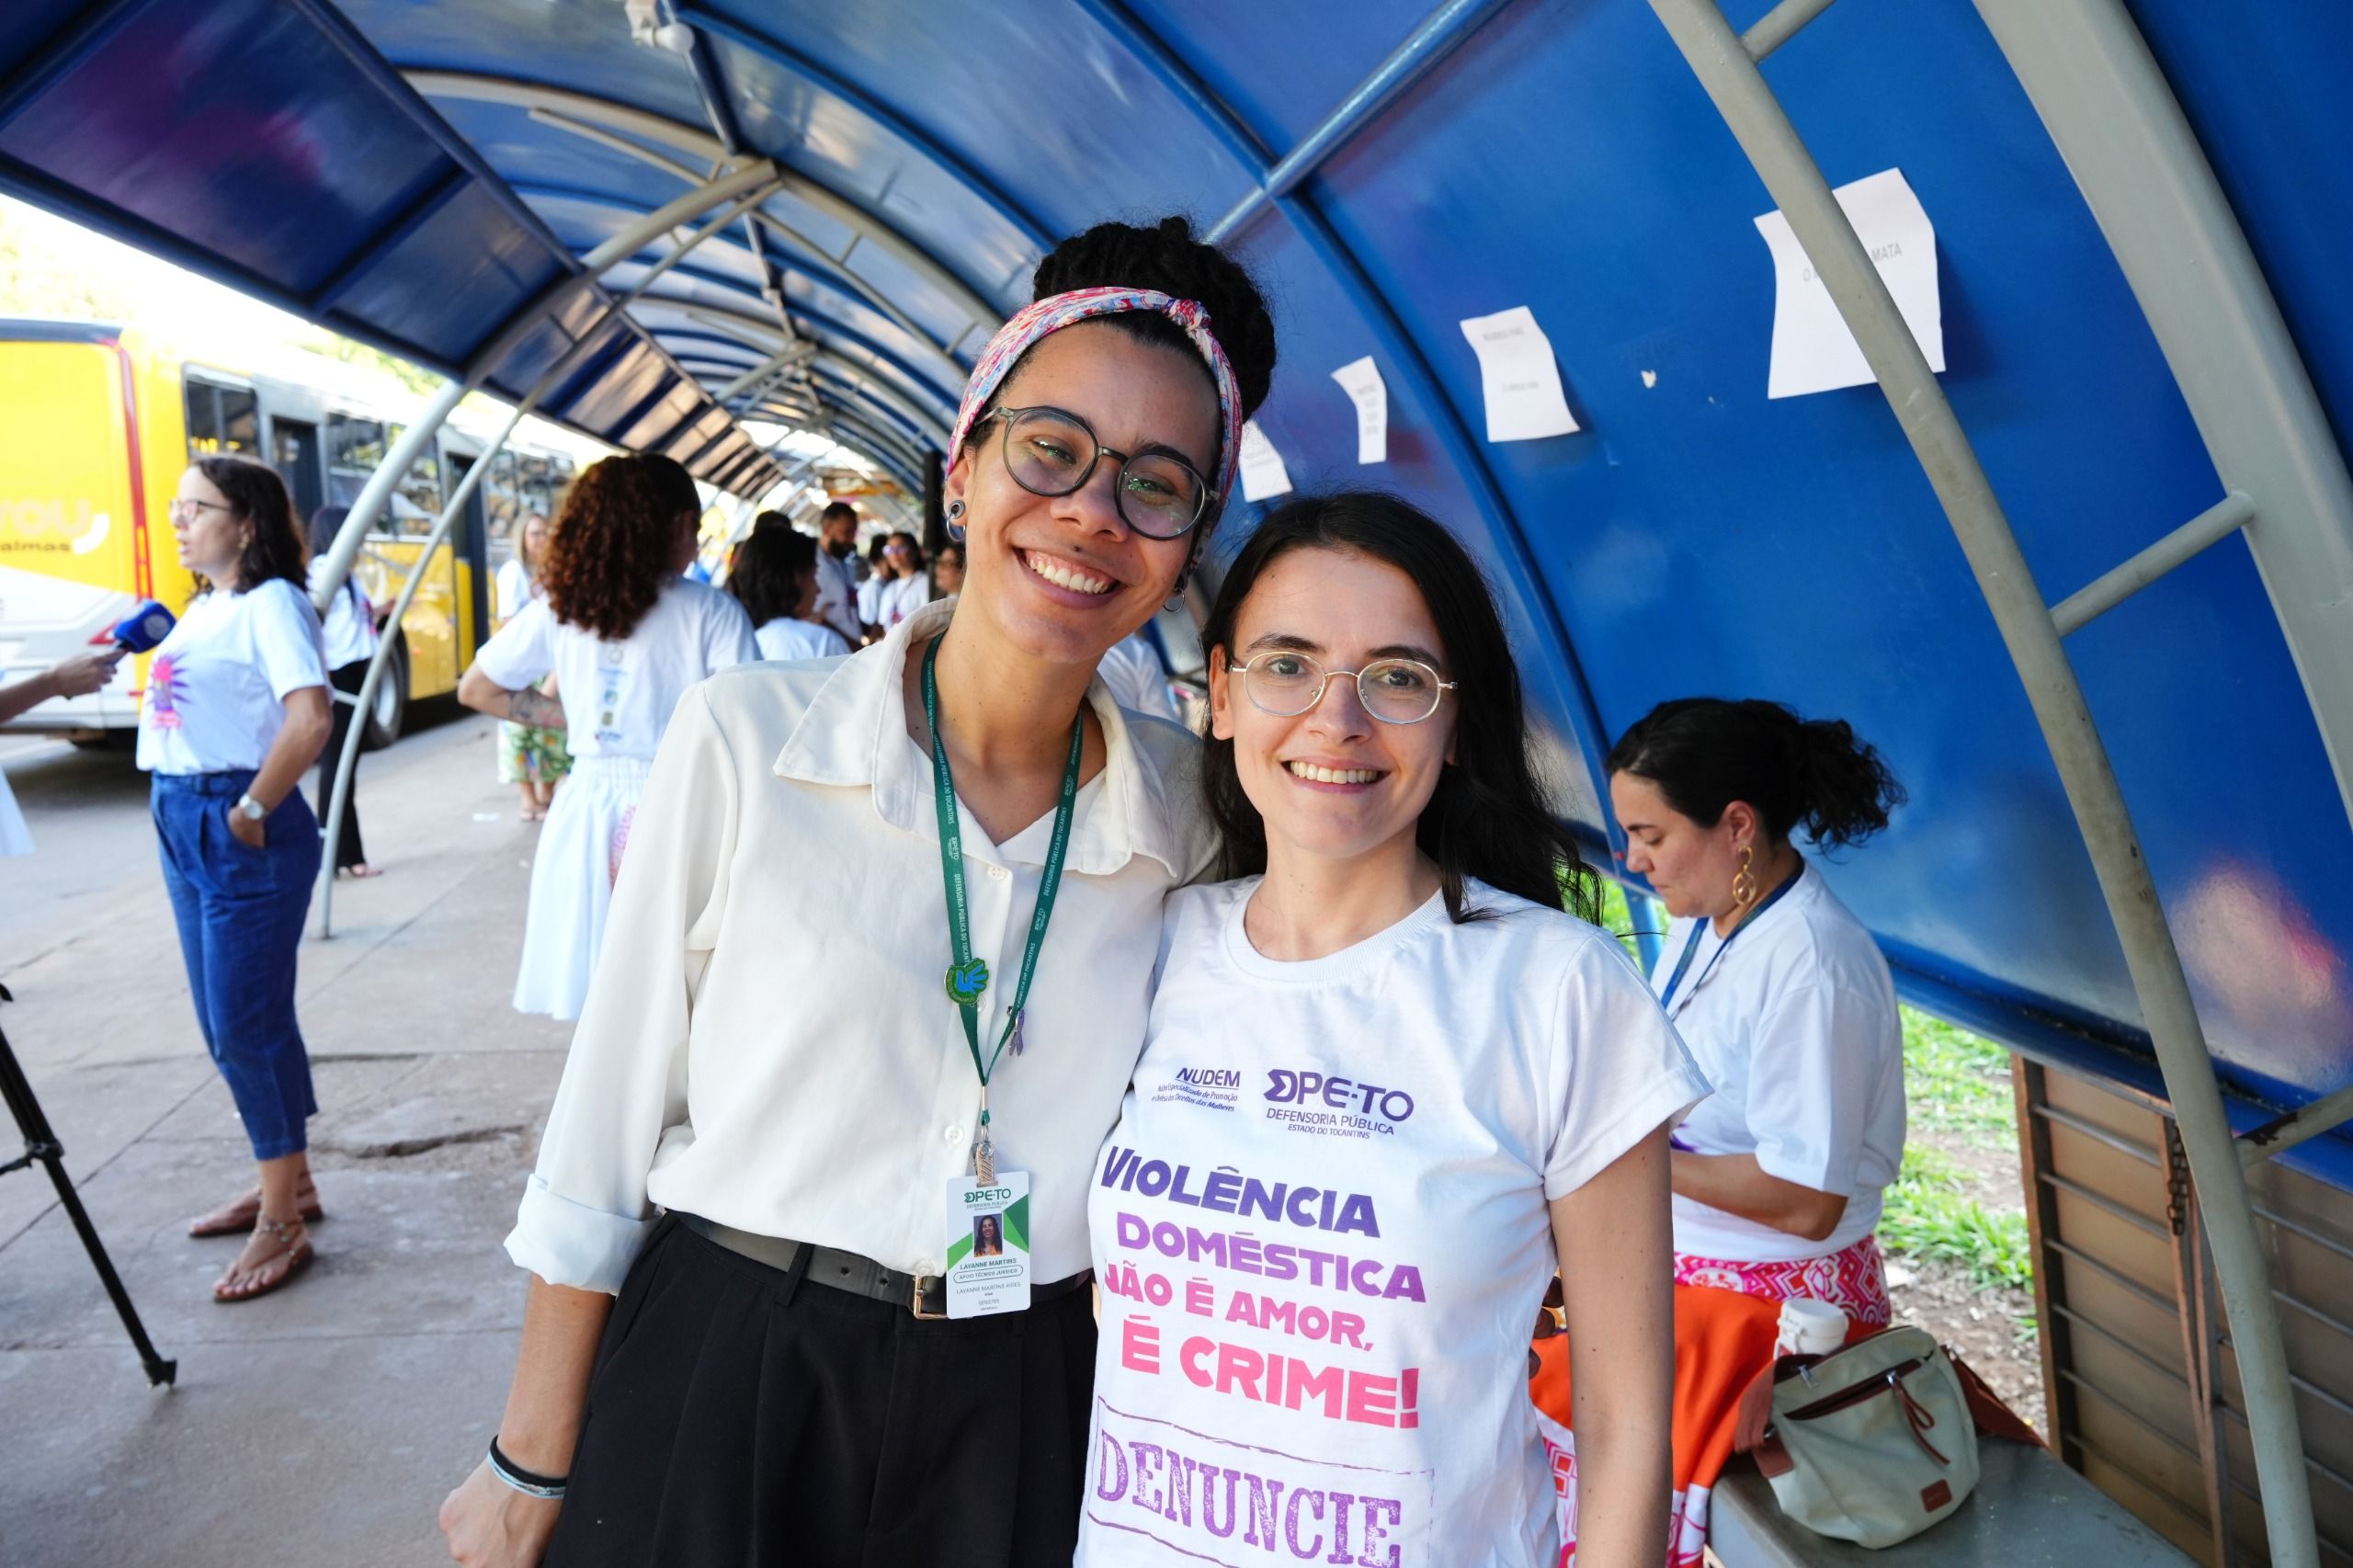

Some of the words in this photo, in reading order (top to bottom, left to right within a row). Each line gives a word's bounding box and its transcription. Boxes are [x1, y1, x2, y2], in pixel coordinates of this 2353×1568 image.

[1872, 243, 1903, 262] MATA
[0, 540, 71, 551] almas
[945, 794, 955, 824] TOCANTINS
[954, 873, 964, 908] DEFENSORIA
[959, 908, 968, 932] PÚBLICA
[1176, 1068, 1241, 1087] NUDEM
[1207, 1101, 1235, 1112] Mulheres
[1211, 1091, 1238, 1102] Promoção
[1267, 1108, 1337, 1126] DEFENSORIA
[1340, 1115, 1394, 1135] PÚBLICA
[1288, 1124, 1315, 1134] ESTADO
[1330, 1129, 1370, 1140] TOCANTINS
[1101, 1145, 1381, 1238] VIOLÊNCIA
[961, 1261, 988, 1270] LAYANNE
[989, 1258, 1017, 1267] MARTINS
[1116, 1211, 1427, 1303] DOMÉSTICA
[957, 1287, 981, 1295] LAYANNE
[1105, 1260, 1173, 1306] NÃO
[1186, 1277, 1213, 1317] É
[1225, 1290, 1374, 1352] AMOR,
[1122, 1314, 1160, 1374] É
[1179, 1335, 1420, 1429] CRIME!
[1097, 1428, 1402, 1568] DENUNCIE
